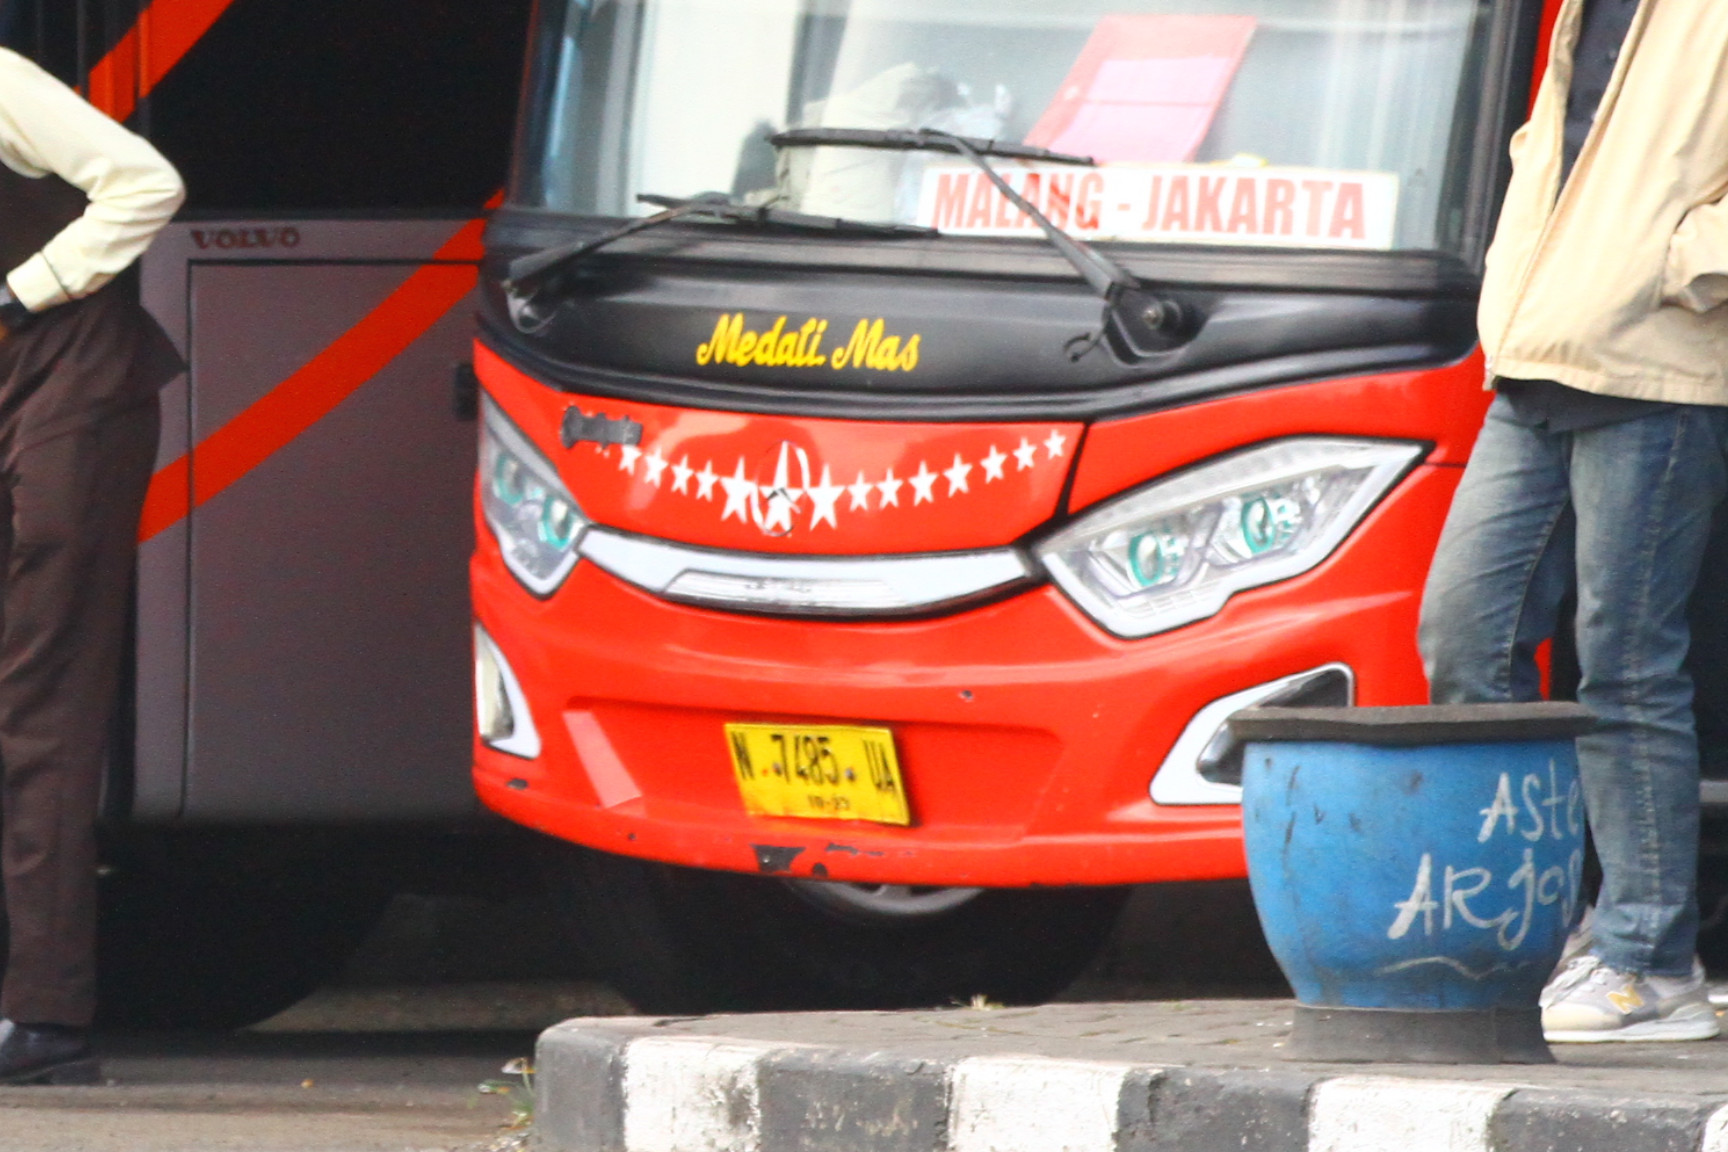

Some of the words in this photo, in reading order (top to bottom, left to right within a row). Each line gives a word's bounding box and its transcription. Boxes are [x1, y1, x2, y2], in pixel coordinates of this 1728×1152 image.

[931, 171, 1105, 231] MALANG
[1140, 175, 1368, 240] JAKARTA
[191, 227, 301, 250] VOLVO
[695, 311, 829, 368] Medali
[829, 317, 922, 373] Mas
[862, 738, 897, 794] UA
